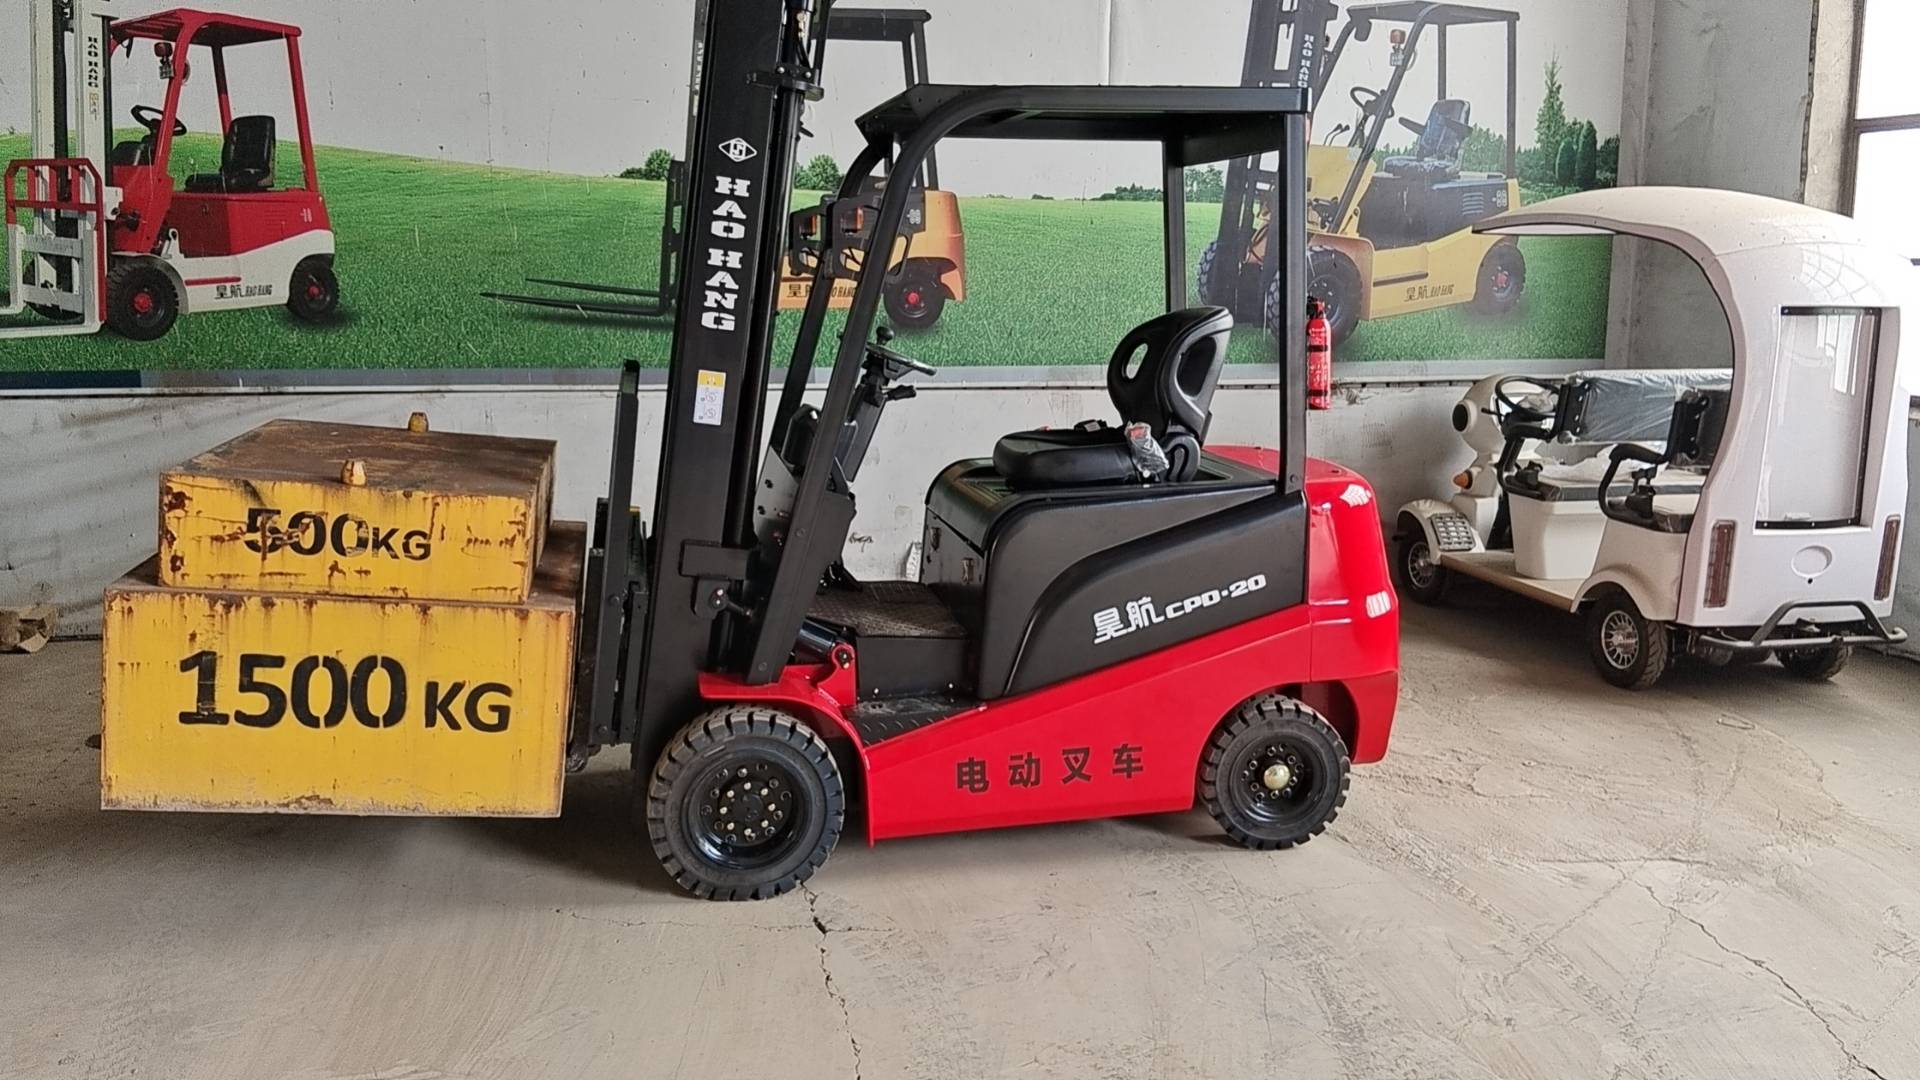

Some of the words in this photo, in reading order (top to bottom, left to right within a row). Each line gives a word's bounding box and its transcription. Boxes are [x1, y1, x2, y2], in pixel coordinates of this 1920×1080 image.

[711, 175, 751, 239] HAO
[701, 248, 743, 331] HANG
[179, 650, 407, 729] 1500
[425, 681, 513, 733] KG
[956, 743, 1144, 794] 电动叉车
